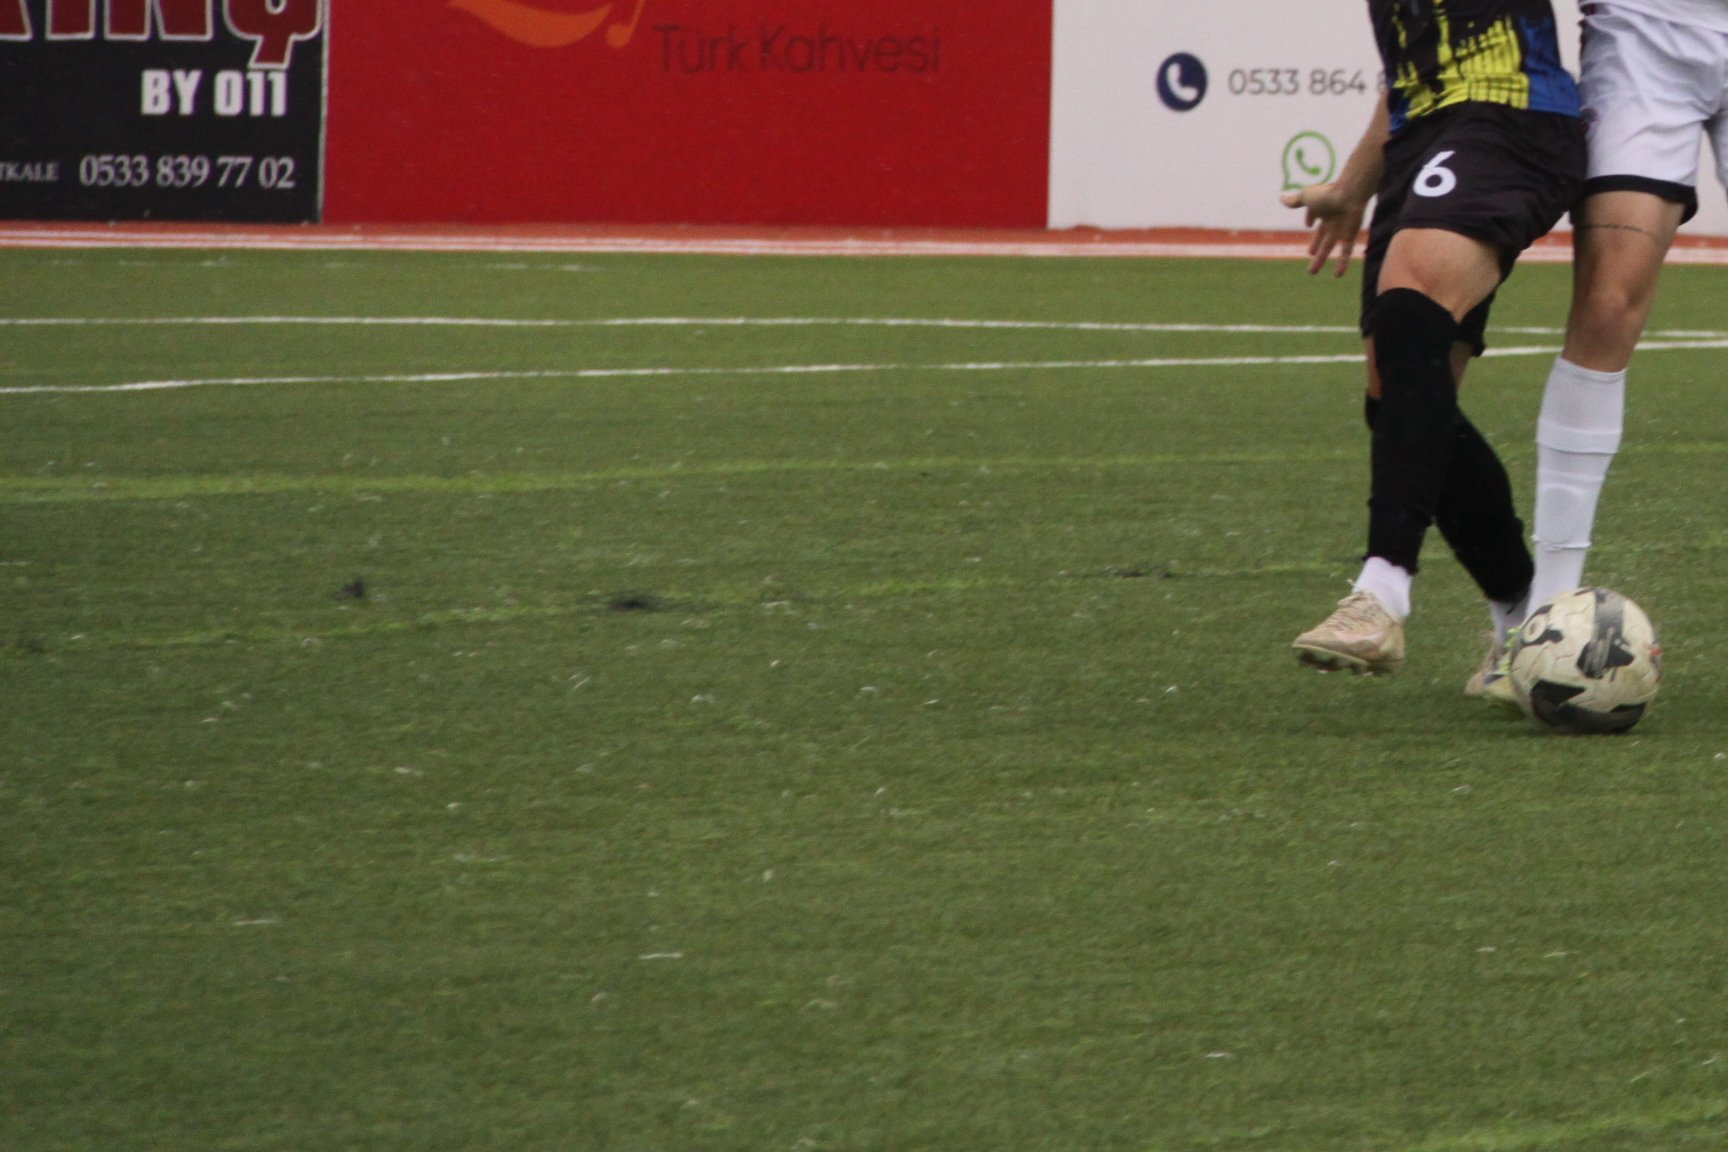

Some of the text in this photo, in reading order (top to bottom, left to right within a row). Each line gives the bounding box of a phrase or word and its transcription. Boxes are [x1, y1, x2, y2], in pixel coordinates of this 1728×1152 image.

[759, 22, 942, 73] Kahvesi
[141, 69, 202, 116] BY
[1228, 68, 1300, 95] 0533
[1309, 68, 1366, 95] 864
[79, 155, 150, 187] 0533
[156, 155, 209, 187] 839
[216, 156, 252, 188] 77
[258, 157, 296, 189] 02
[1412, 150, 1457, 198] 6
